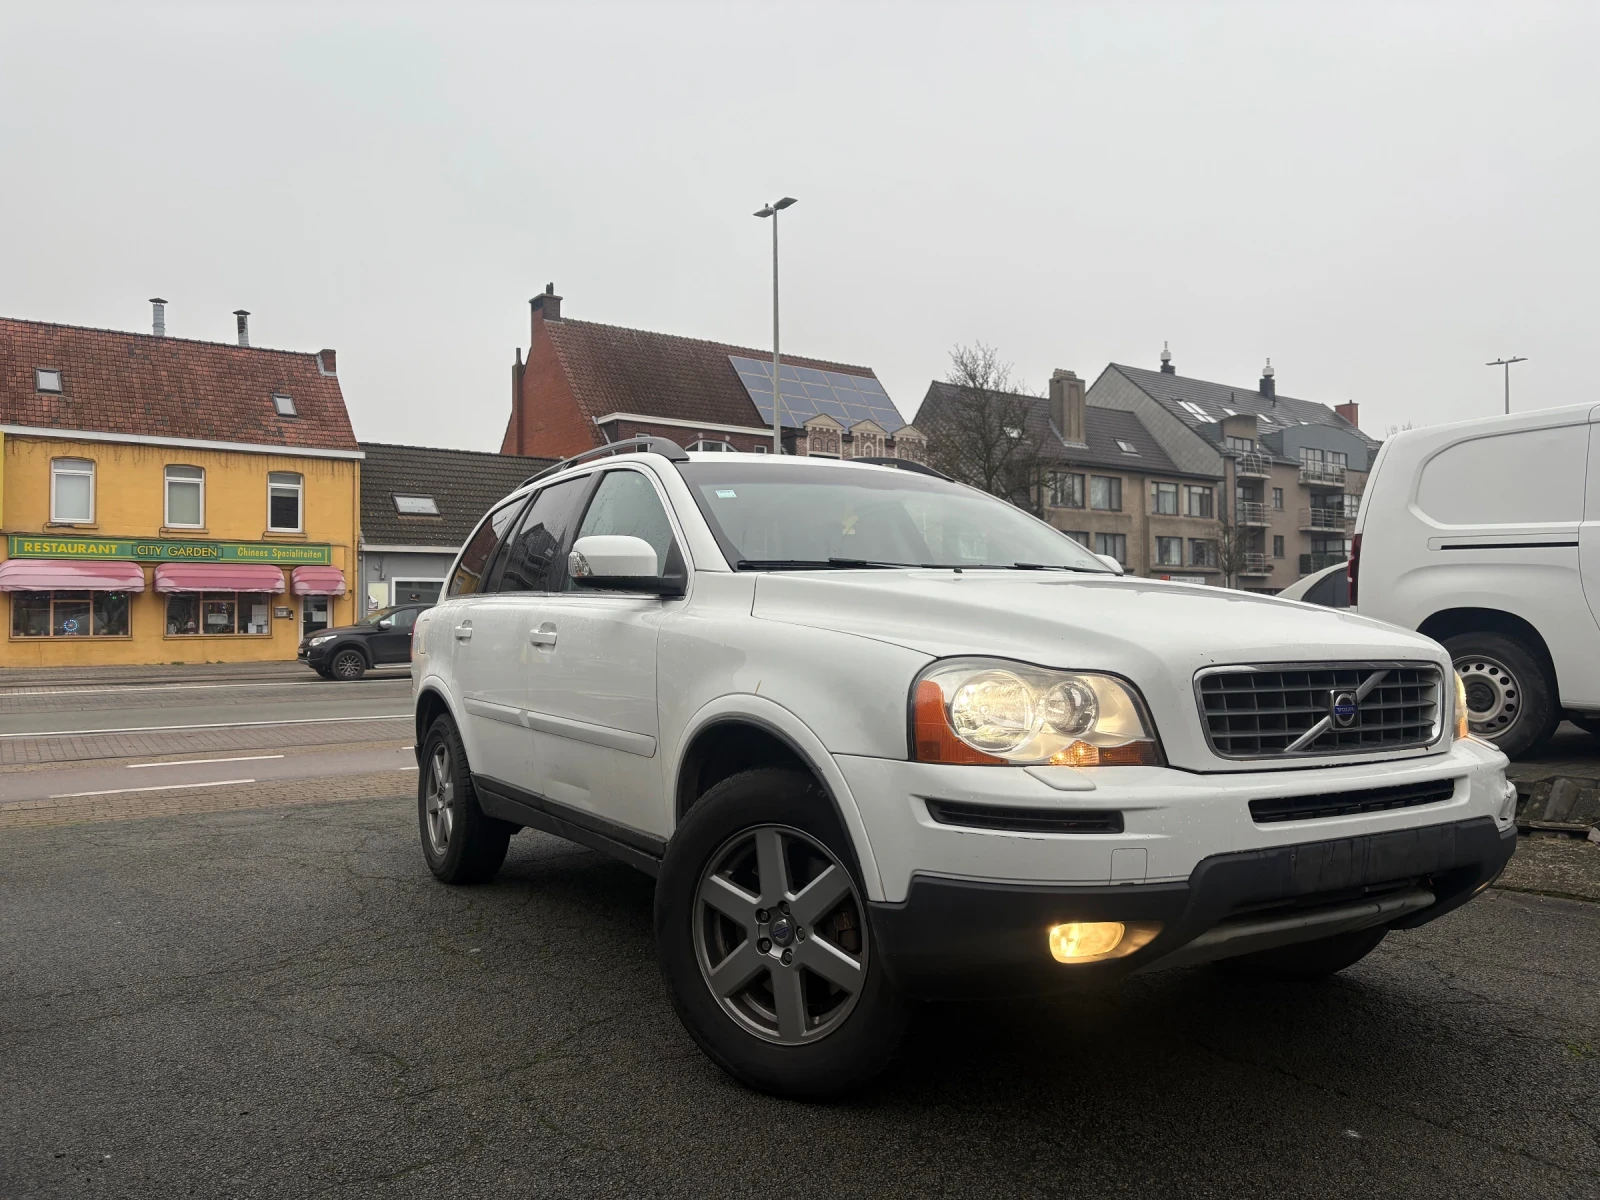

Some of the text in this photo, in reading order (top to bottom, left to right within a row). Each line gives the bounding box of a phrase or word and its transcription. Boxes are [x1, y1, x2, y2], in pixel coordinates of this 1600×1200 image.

[24, 542, 118, 554] RESTAURANT
[137, 545, 218, 557] CITY GARDEN
[237, 546, 322, 559] Chinees Specialiteiten
